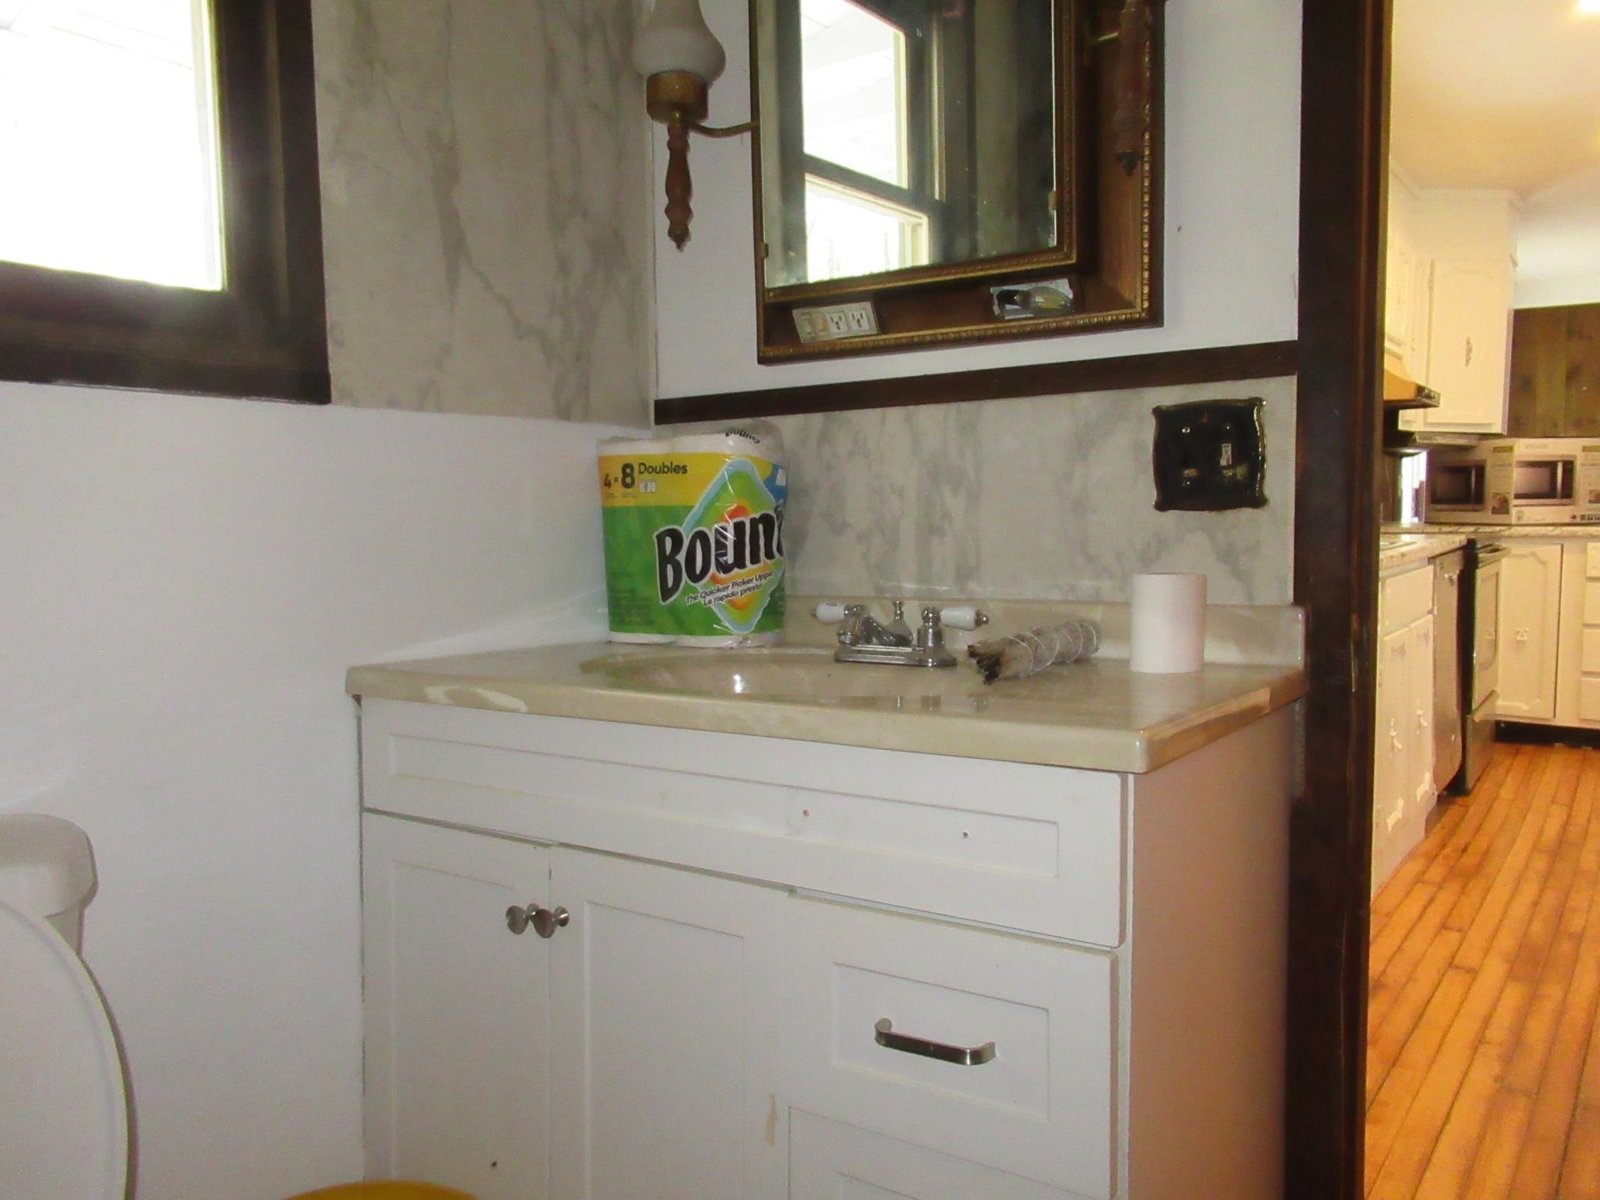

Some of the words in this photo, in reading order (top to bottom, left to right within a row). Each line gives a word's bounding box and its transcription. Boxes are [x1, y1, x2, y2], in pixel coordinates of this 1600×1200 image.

[603, 473, 612, 489] 4
[620, 462, 636, 489] 8
[637, 461, 689, 475] Doubles
[701, 584, 730, 599] Quicker
[731, 577, 754, 588] Picker
